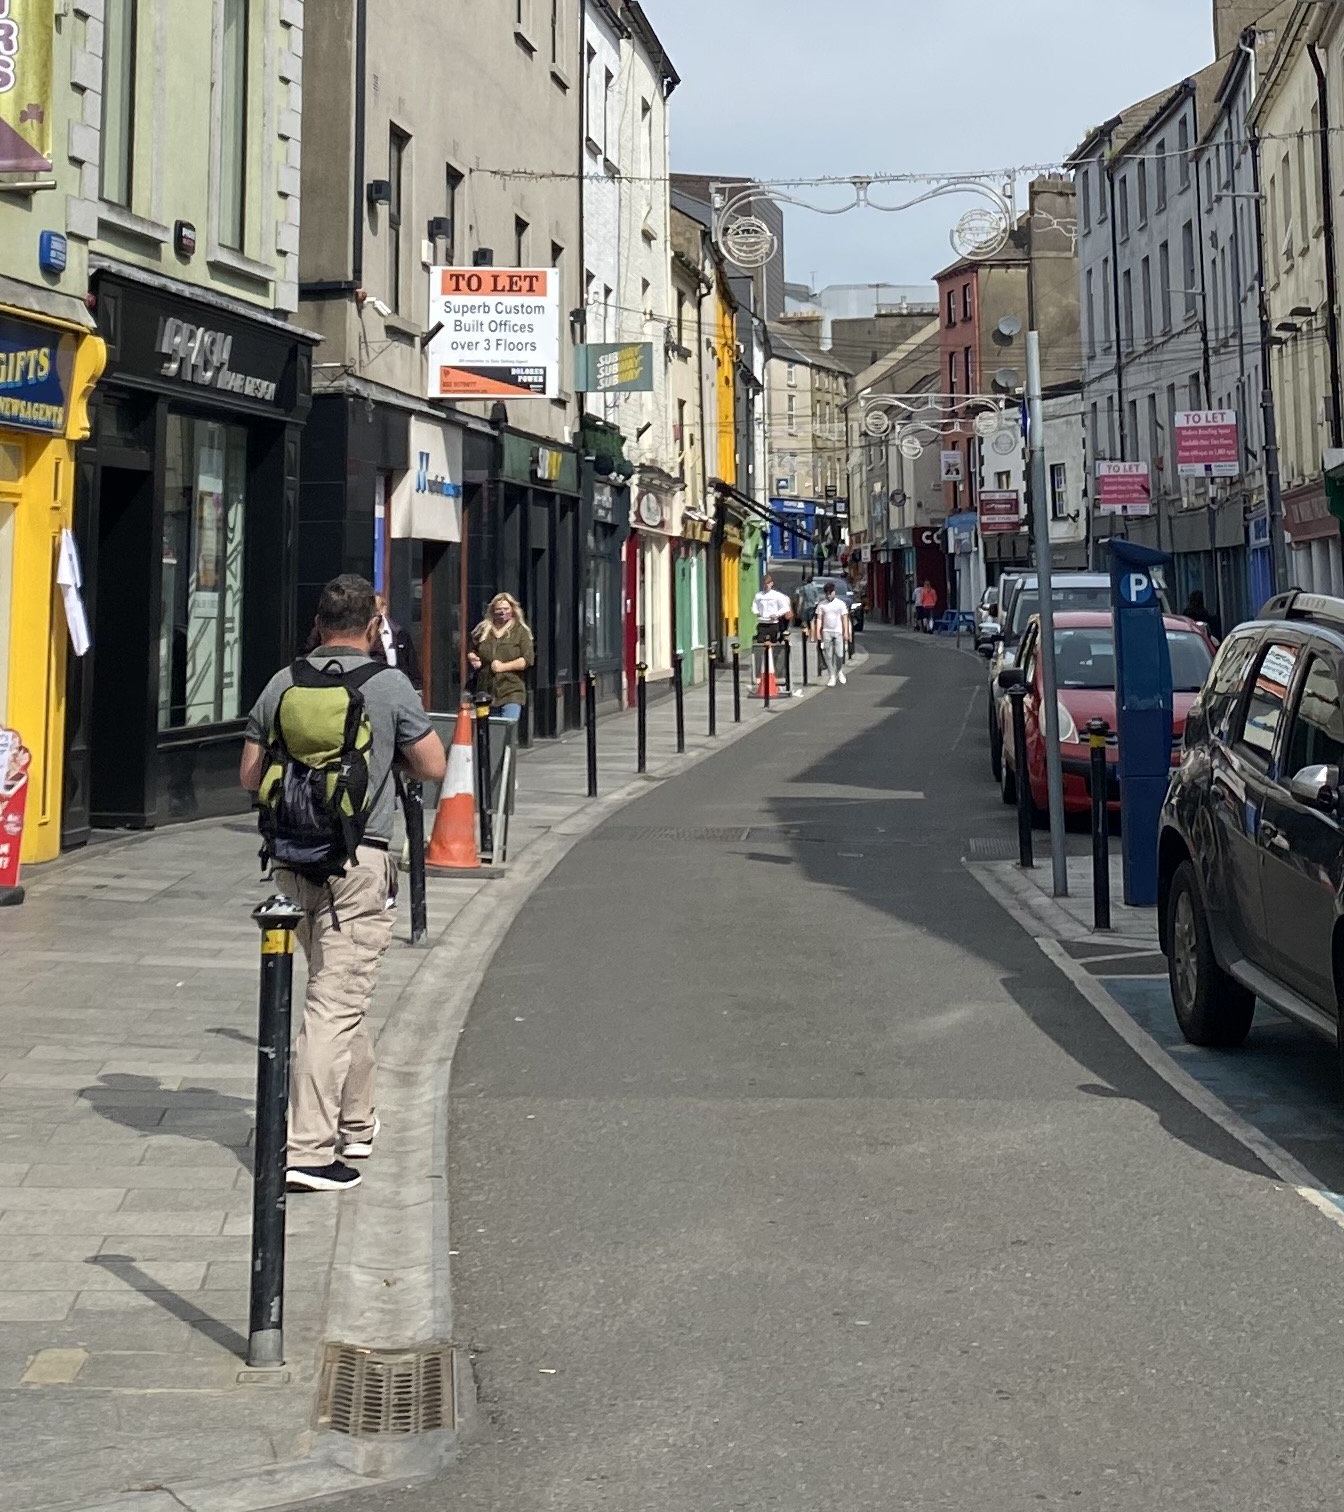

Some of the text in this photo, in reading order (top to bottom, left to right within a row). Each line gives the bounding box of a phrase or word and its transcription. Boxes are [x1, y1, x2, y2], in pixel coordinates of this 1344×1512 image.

[449, 273, 539, 293] TO LET
[443, 301, 545, 319] Superb Custom
[453, 320, 534, 333] Built Offices
[451, 339, 537, 351] over 3 Floors
[1184, 412, 1226, 424] TO LET
[1106, 464, 1140, 473] TO LET
[1130, 573, 1148, 601] P
